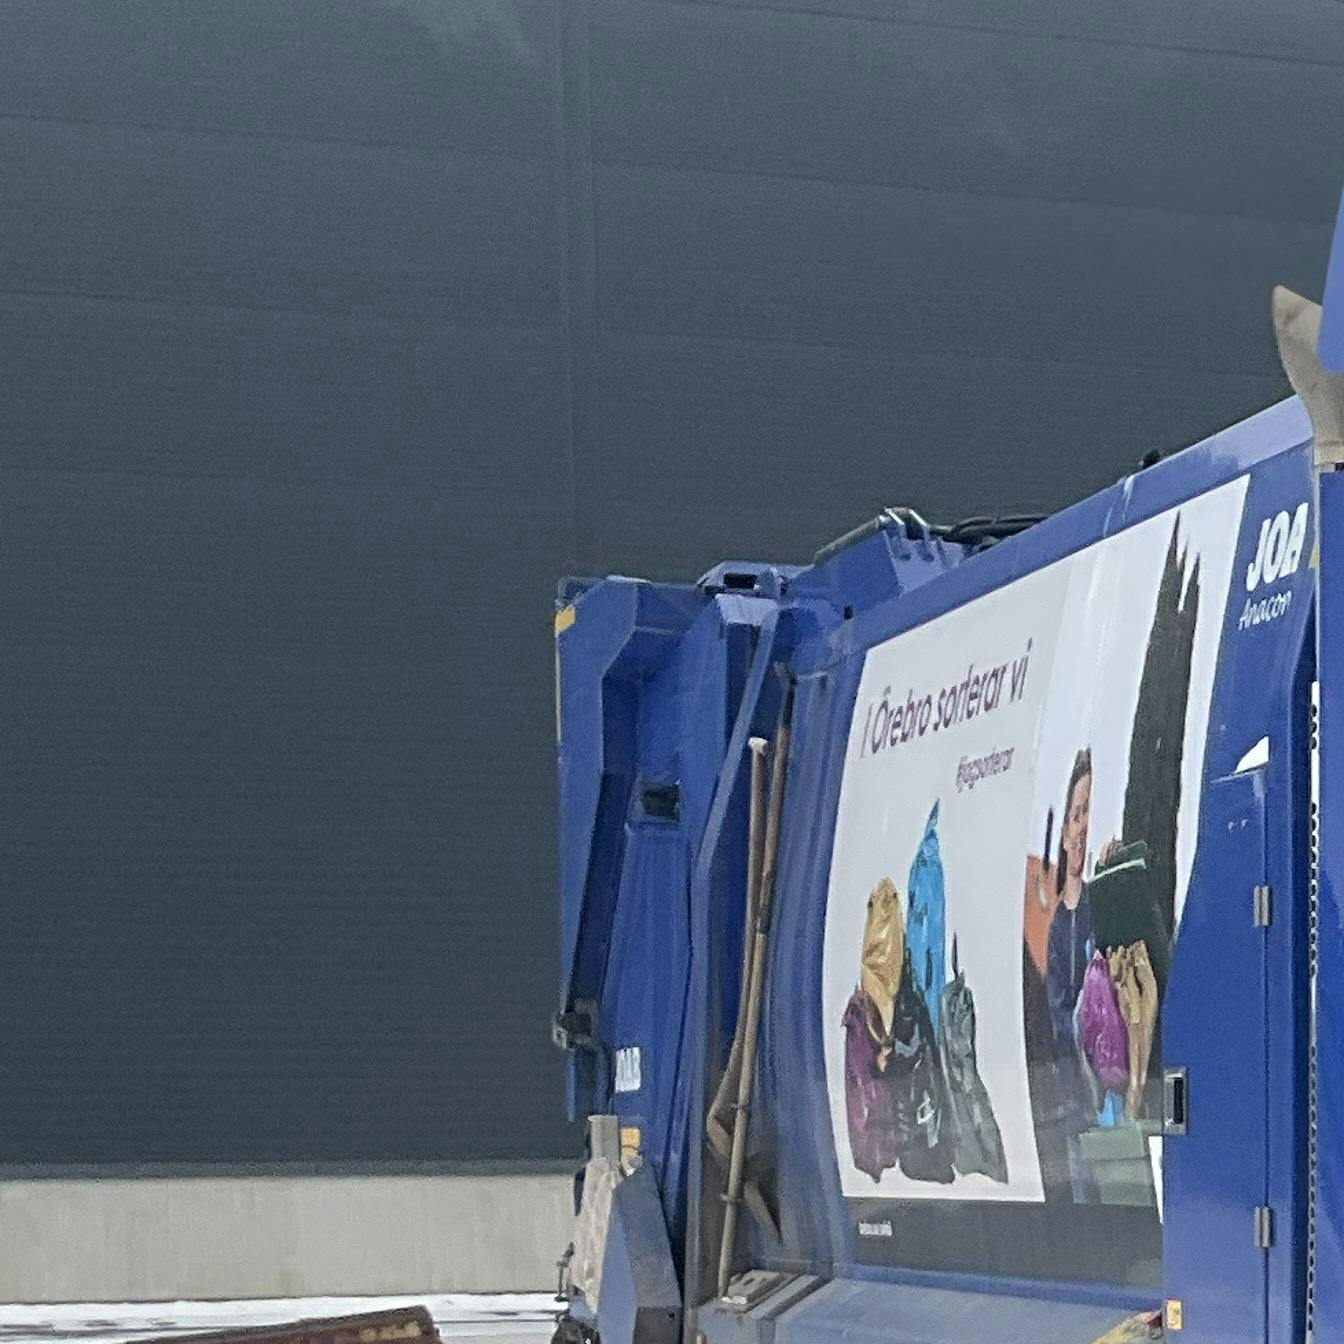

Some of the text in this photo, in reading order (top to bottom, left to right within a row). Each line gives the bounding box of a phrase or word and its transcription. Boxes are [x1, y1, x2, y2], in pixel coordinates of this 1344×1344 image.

[860, 637, 1033, 760] I Örebro sorterar vi
